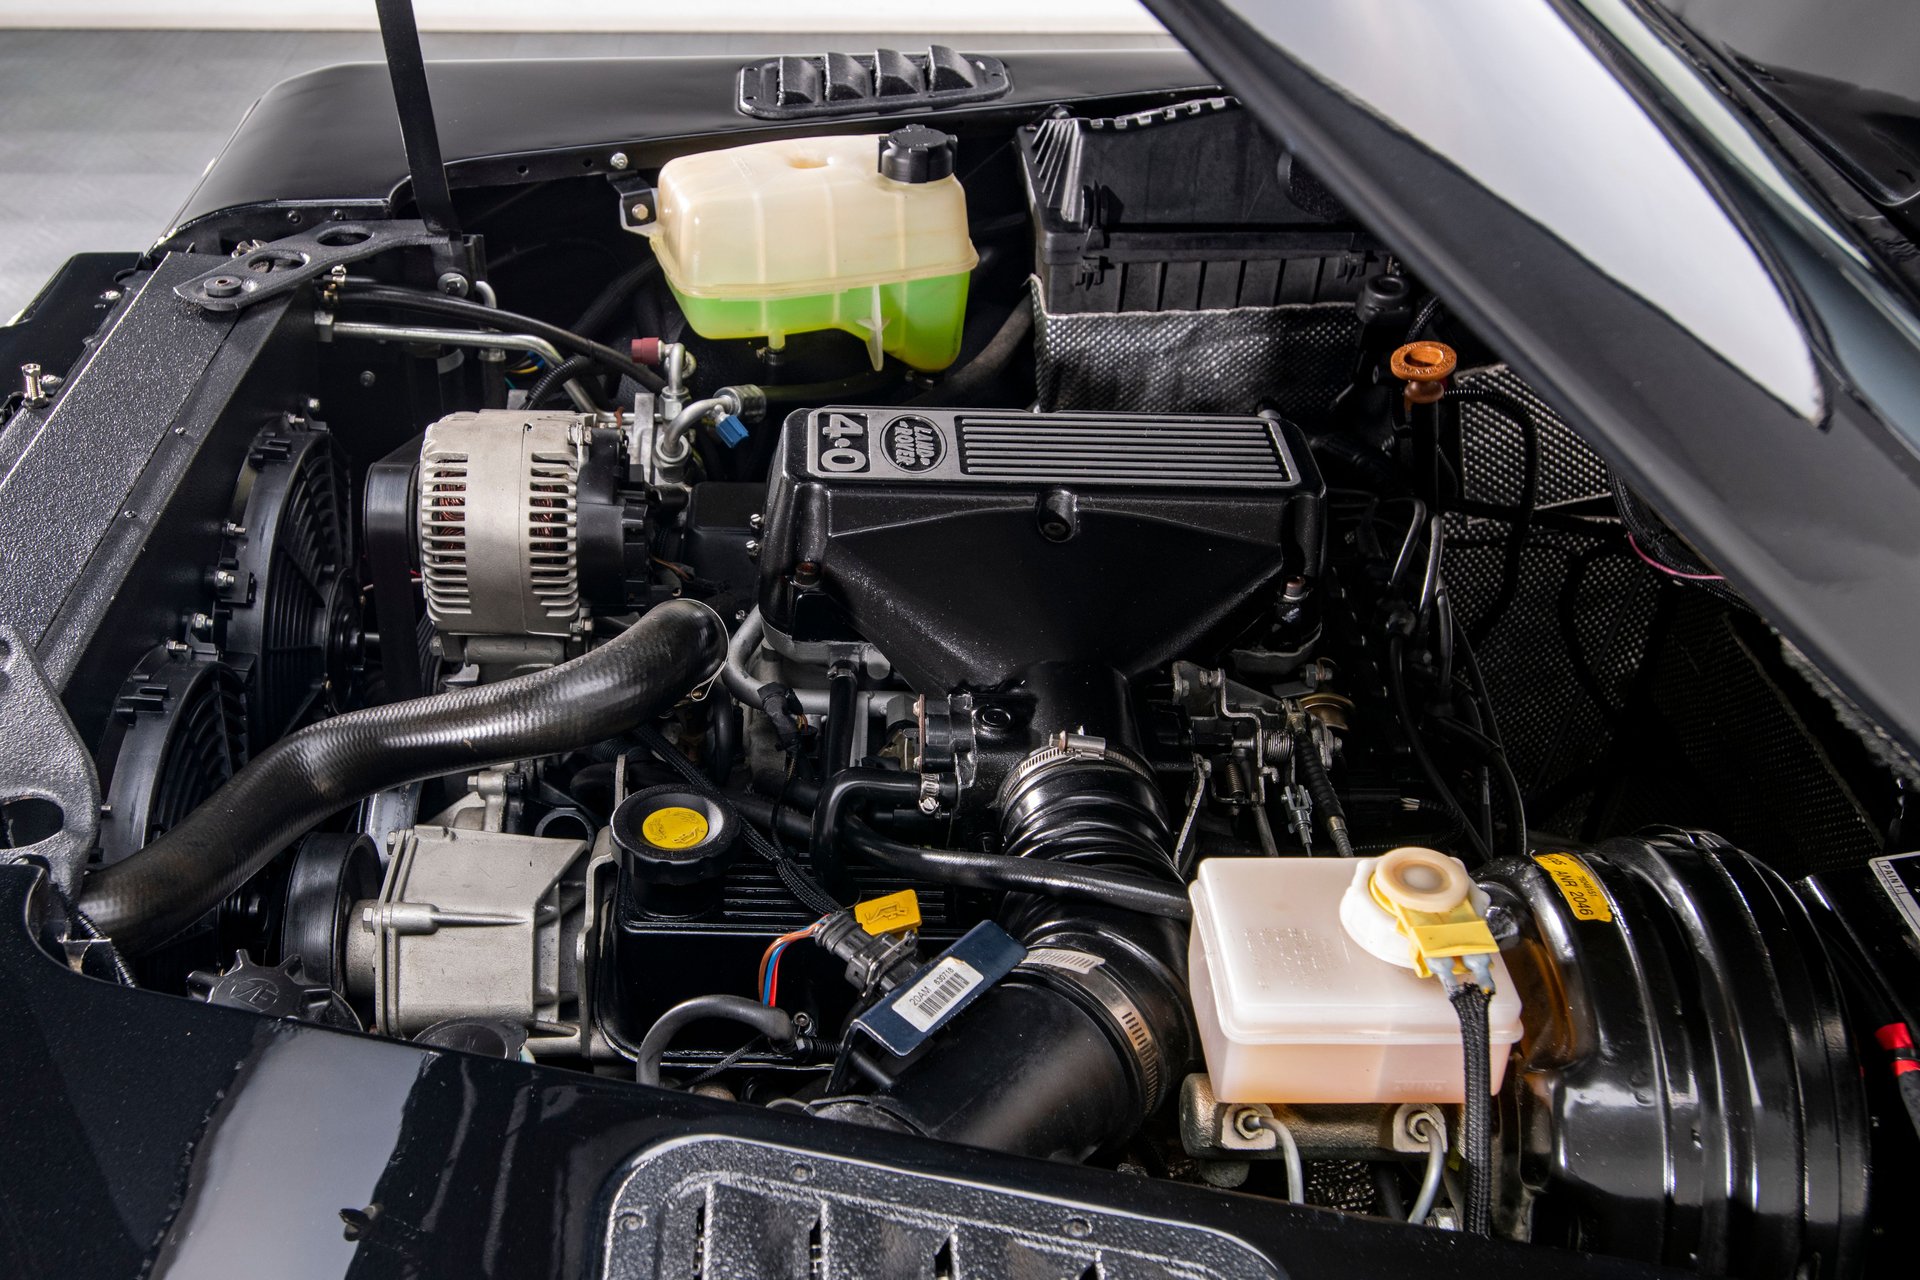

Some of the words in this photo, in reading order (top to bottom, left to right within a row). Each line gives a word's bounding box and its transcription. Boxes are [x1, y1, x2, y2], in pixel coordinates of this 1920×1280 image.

[1554, 870, 1578, 887] ANR
[1569, 891, 1594, 915] 2046
[909, 986, 931, 1006] 20AM
